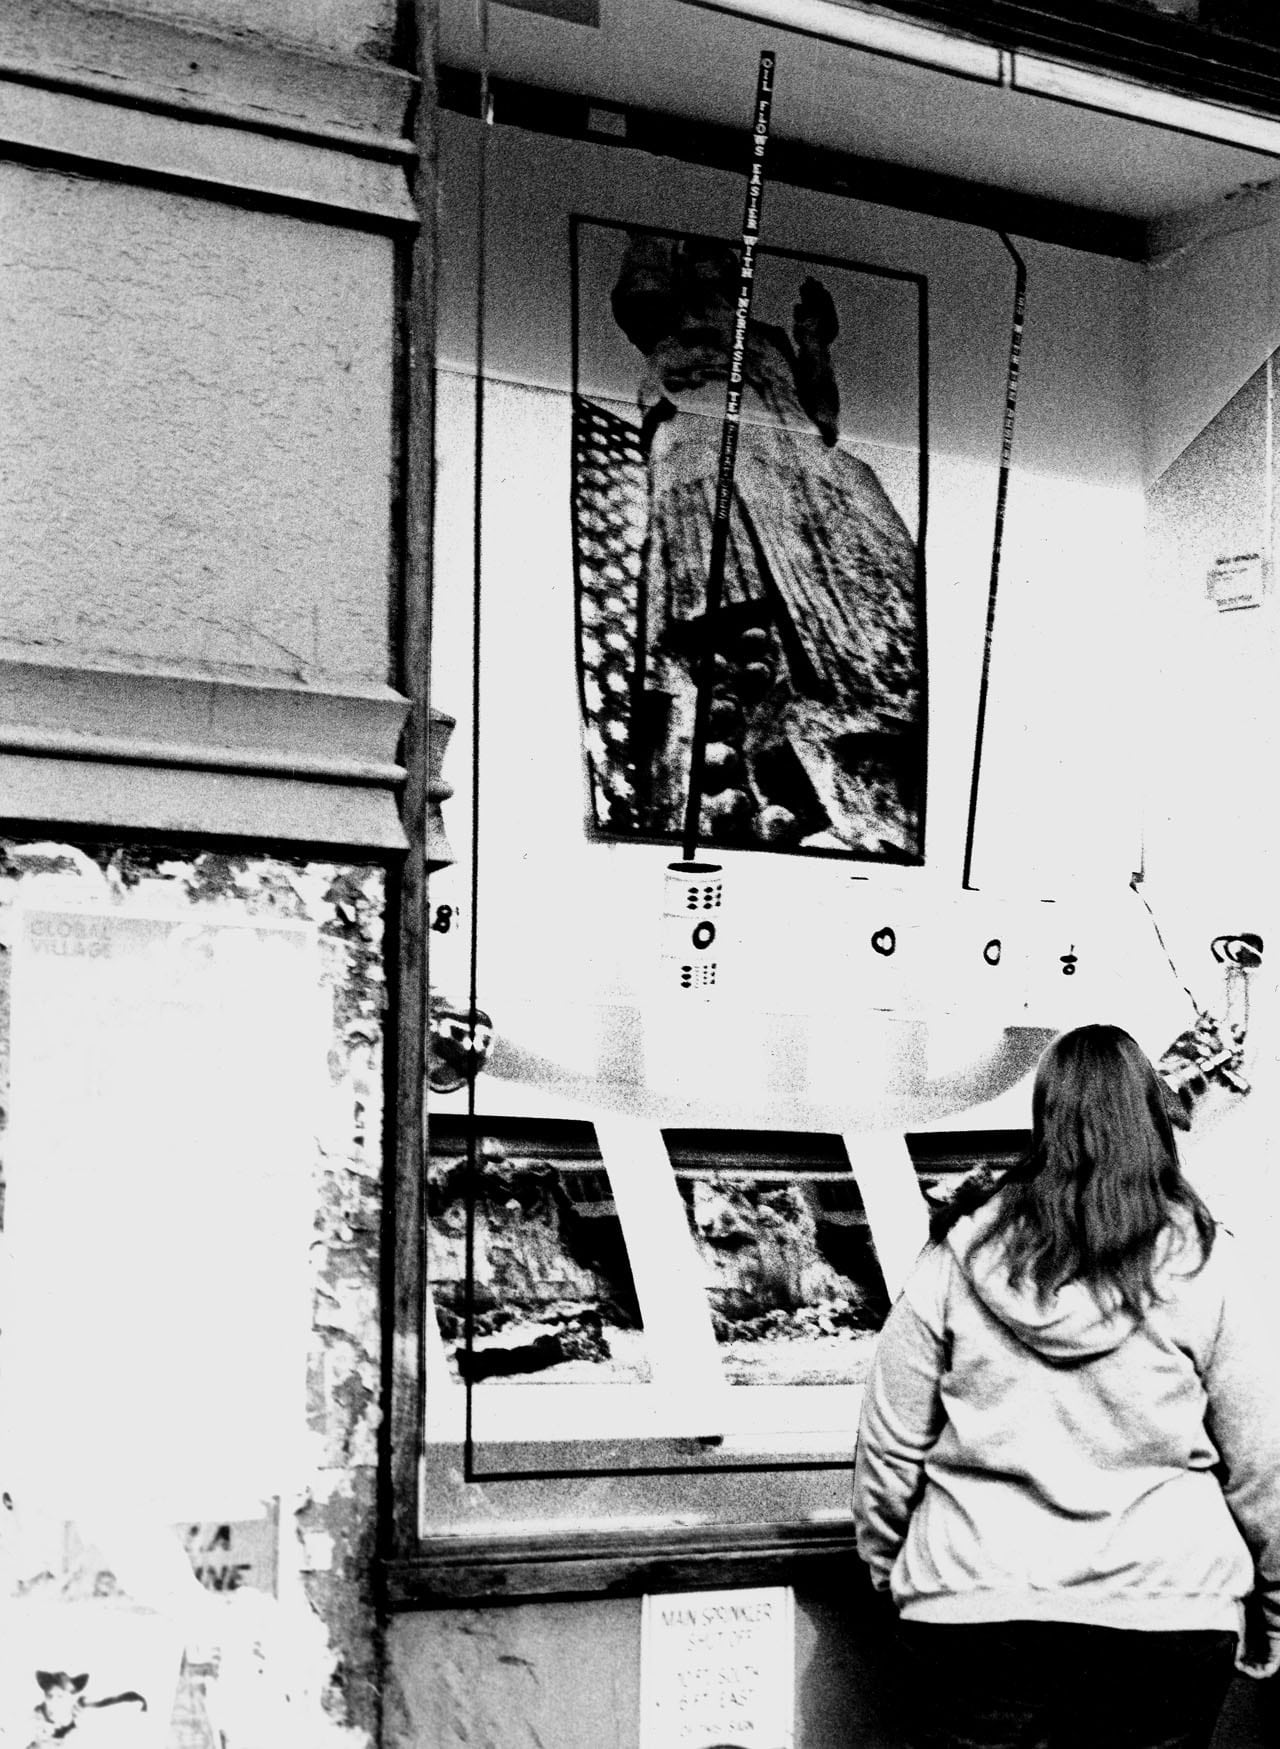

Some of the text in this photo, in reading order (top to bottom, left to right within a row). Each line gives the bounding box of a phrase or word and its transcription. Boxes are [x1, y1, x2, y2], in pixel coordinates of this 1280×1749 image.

[761, 57, 773, 92] OIL
[753, 100, 769, 157] FLOWS
[747, 163, 762, 230] EASIER
[741, 234, 759, 279] WITH
[730, 286, 750, 383] INCREASED
